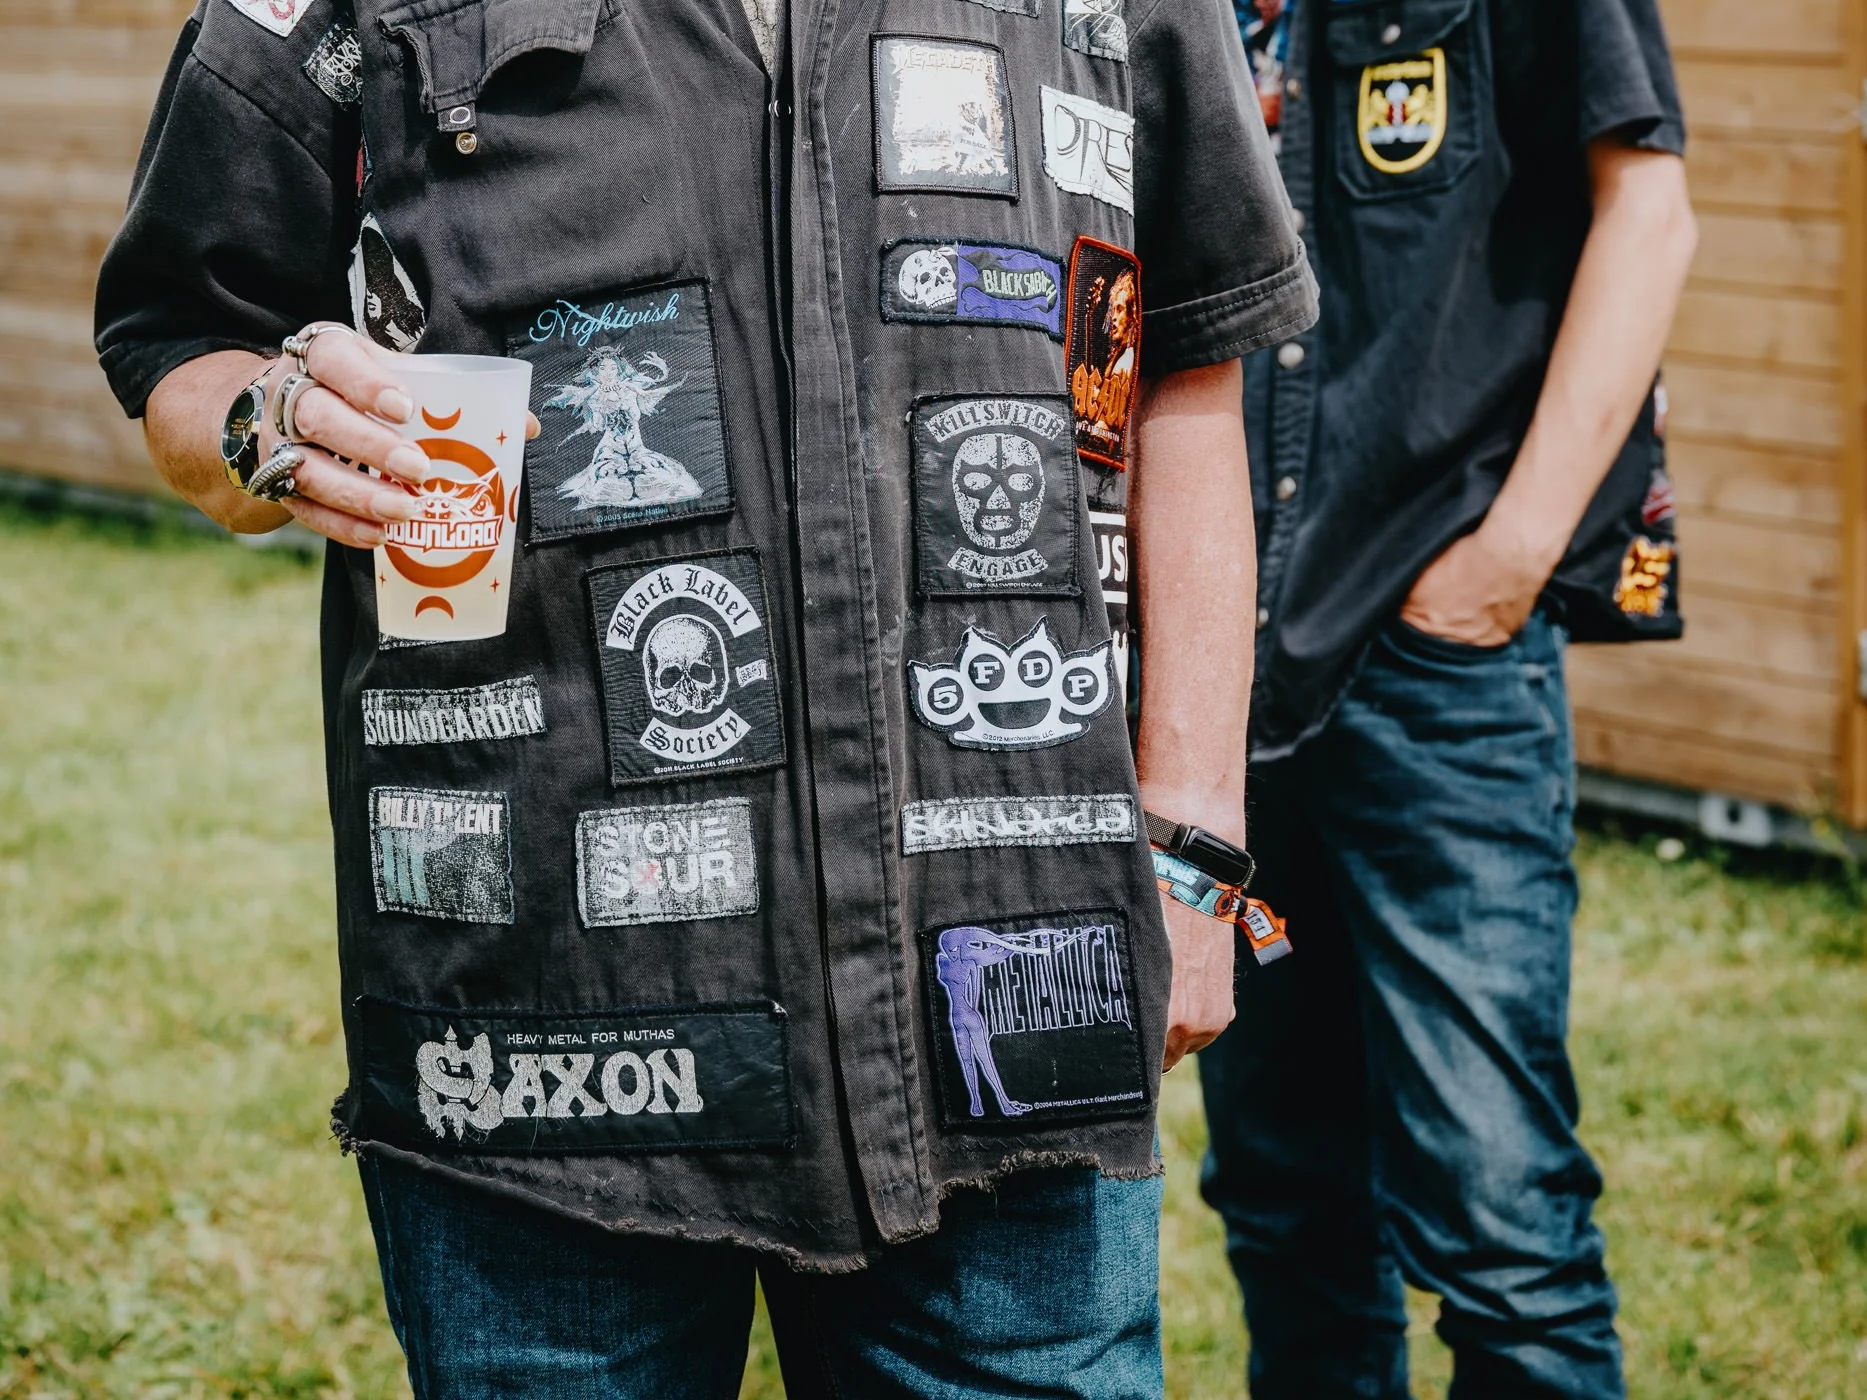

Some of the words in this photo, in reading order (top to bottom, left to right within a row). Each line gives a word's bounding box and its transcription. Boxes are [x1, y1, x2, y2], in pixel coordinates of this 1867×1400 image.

[982, 269, 1024, 297] BLACK
[529, 293, 680, 346] Nightwish
[933, 402, 1064, 439] KILLSWITCH
[956, 552, 1042, 576] ENGAGE
[610, 570, 675, 645] Black
[683, 567, 752, 626] Label
[645, 715, 742, 755] Society
[674, 763, 695, 771] BLACK
[697, 760, 717, 769] LABEL
[718, 756, 744, 766] SOCIETY
[379, 796, 431, 829] BILLY
[597, 816, 731, 857] STONE
[602, 850, 738, 903] SOUR
[980, 925, 1133, 1041] METALLICA
[506, 1033, 544, 1045] HEAVY
[548, 1033, 587, 1045] METAL
[591, 1031, 618, 1043] FOR
[623, 1028, 675, 1042] MUTHAS
[416, 1025, 704, 1140] SAXON
